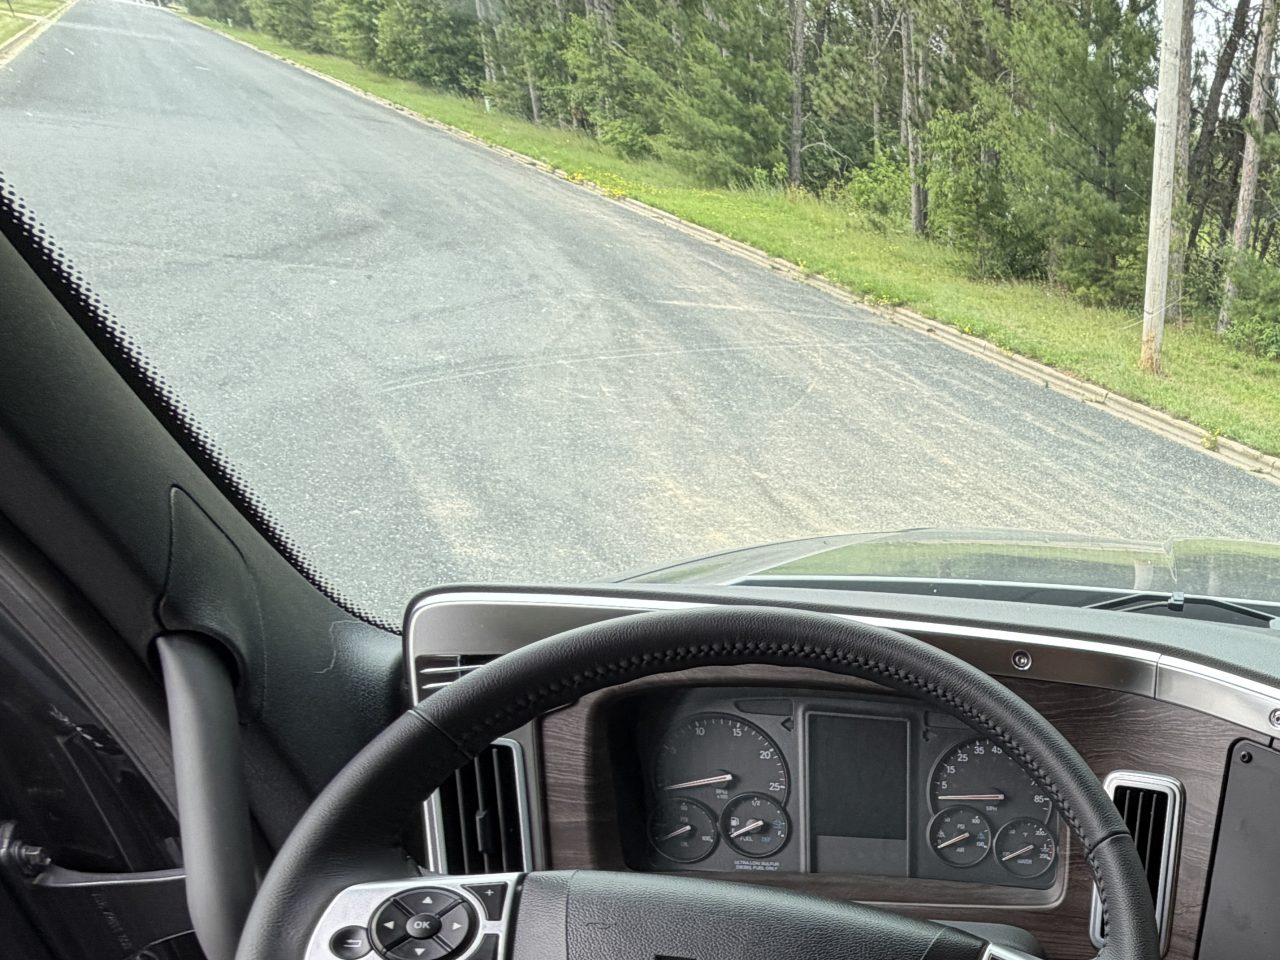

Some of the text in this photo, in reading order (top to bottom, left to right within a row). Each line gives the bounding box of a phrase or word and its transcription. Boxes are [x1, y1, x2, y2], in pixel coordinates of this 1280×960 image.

[695, 728, 705, 736] 10
[732, 728, 742, 737] 15
[974, 746, 984, 754] 35
[991, 745, 1003, 754] 45
[760, 751, 771, 759] 20
[957, 753, 968, 761] 25
[946, 765, 956, 774] 15
[769, 782, 780, 791] 25
[941, 781, 948, 789] 5
[1034, 795, 1044, 803] 85
[413, 920, 430, 929] OK
